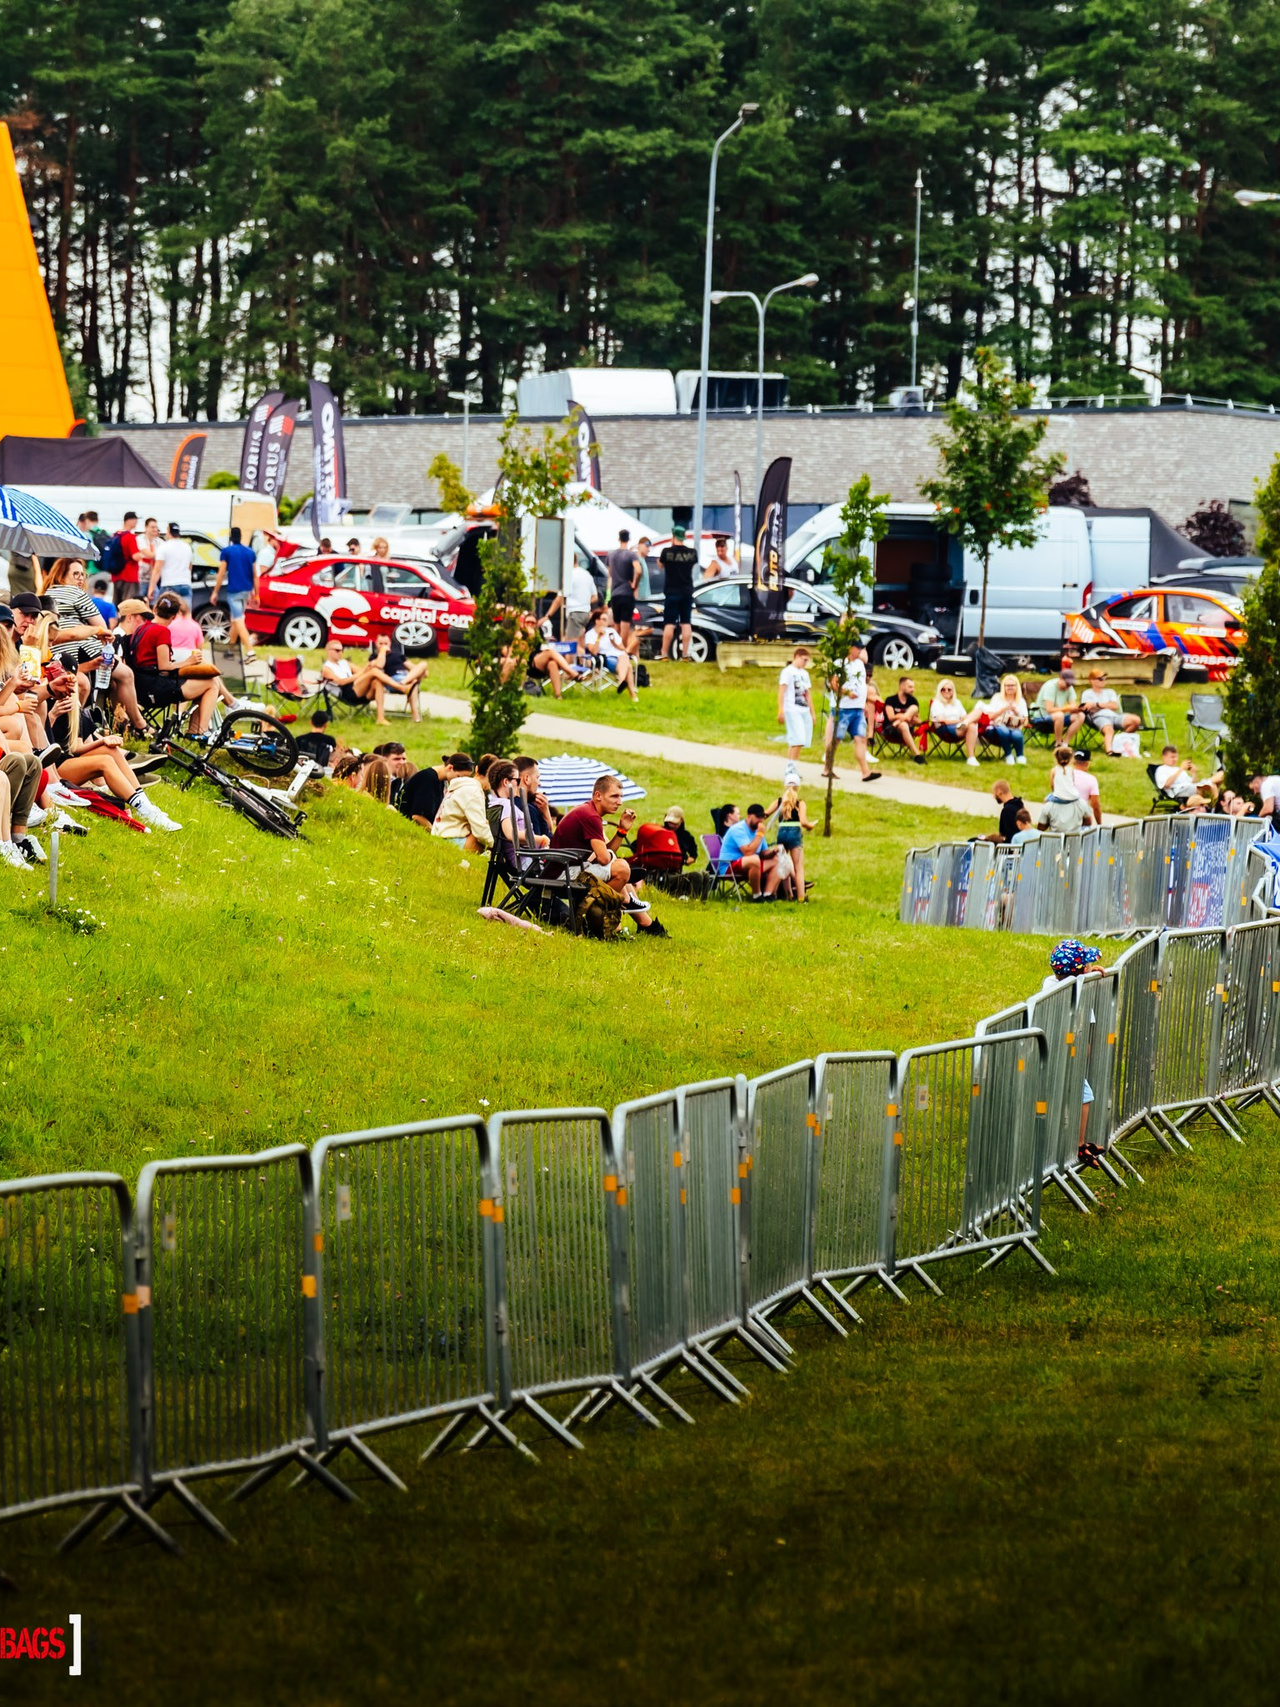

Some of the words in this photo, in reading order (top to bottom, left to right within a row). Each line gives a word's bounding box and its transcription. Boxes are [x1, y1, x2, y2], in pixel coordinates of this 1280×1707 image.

[263, 442, 281, 495] ORUS
[666, 552, 696, 562] RAW
[769, 549, 779, 592] AUTO
